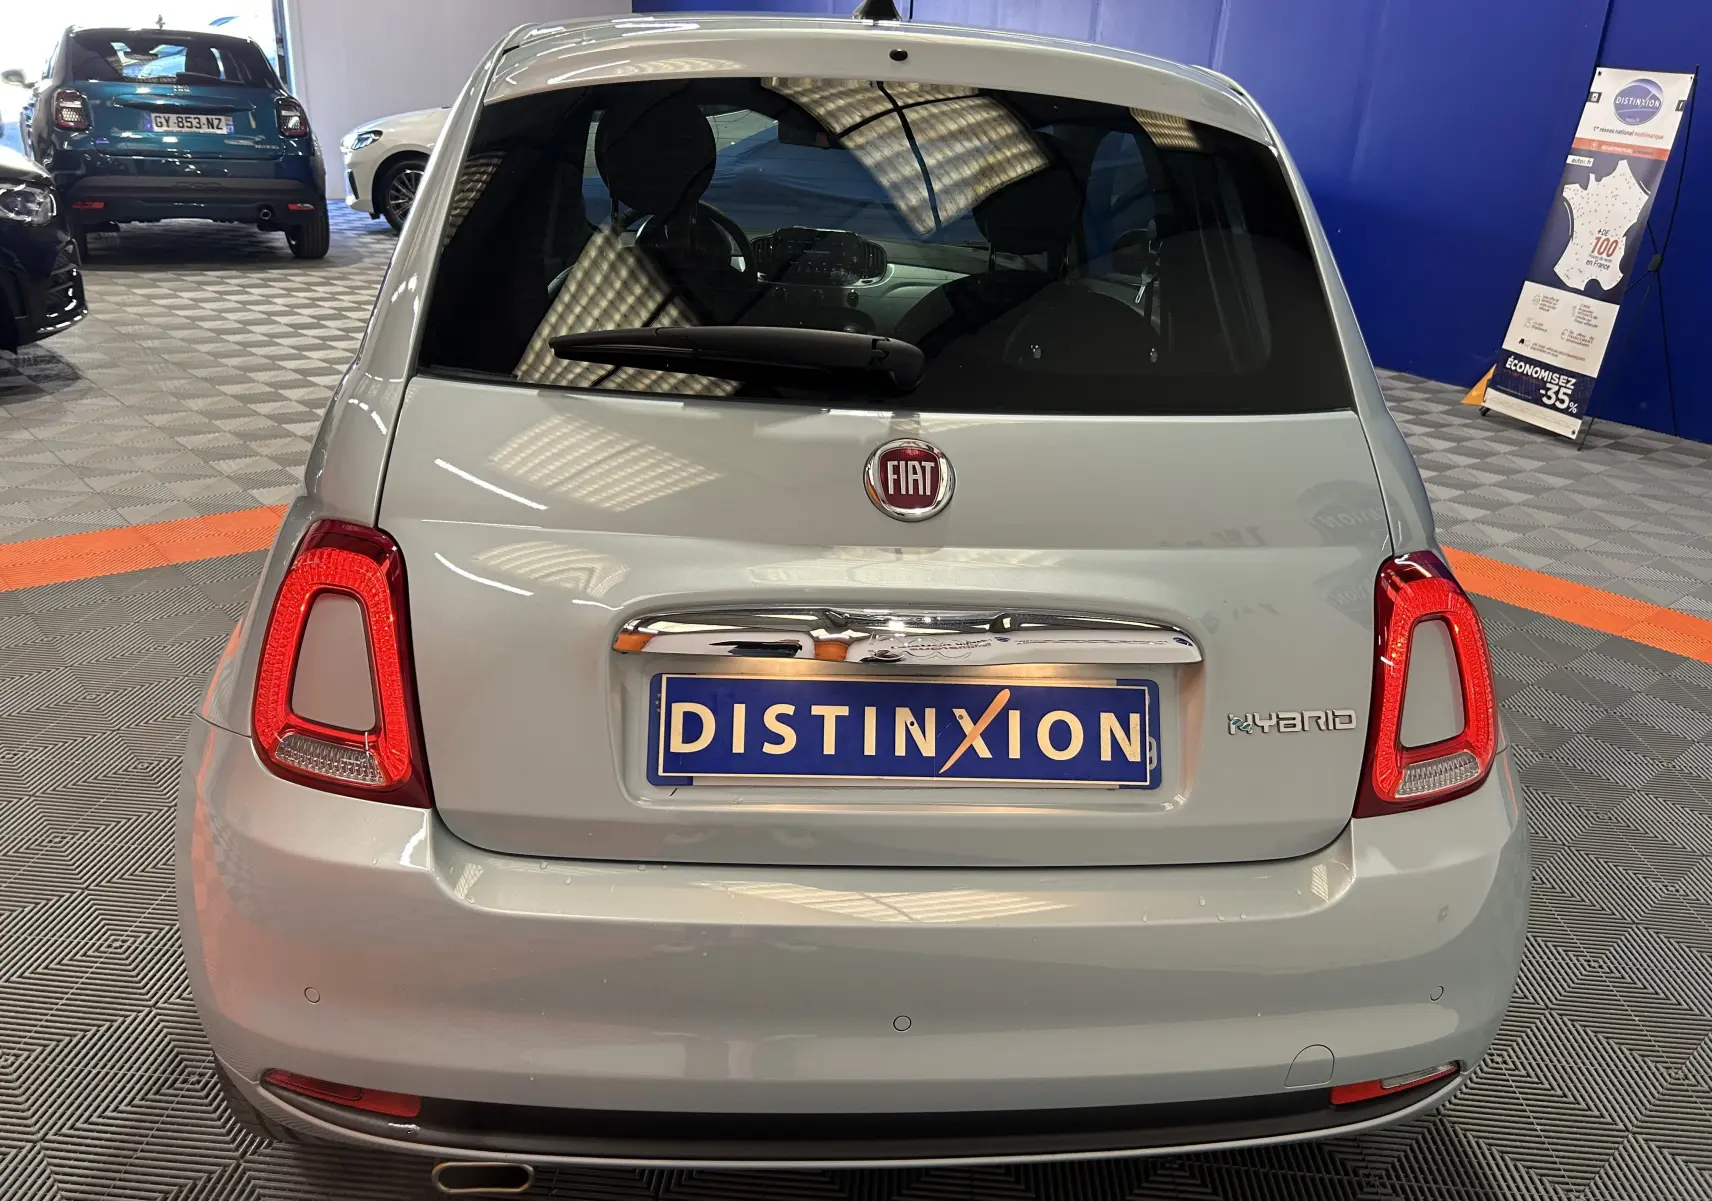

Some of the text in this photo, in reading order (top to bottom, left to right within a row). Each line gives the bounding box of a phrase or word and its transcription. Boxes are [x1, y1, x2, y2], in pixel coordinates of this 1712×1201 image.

[1615, 94, 1661, 109] DISTINXION
[154, 115, 224, 130] GY-853-NZ
[1591, 236, 1619, 257] 100
[1593, 259, 1611, 271] France
[1505, 355, 1577, 390] ÉCONOMISEZ
[887, 460, 935, 496] FIAT
[670, 689, 1141, 774] DISTINXION
[1227, 709, 1357, 735] HYBRID
